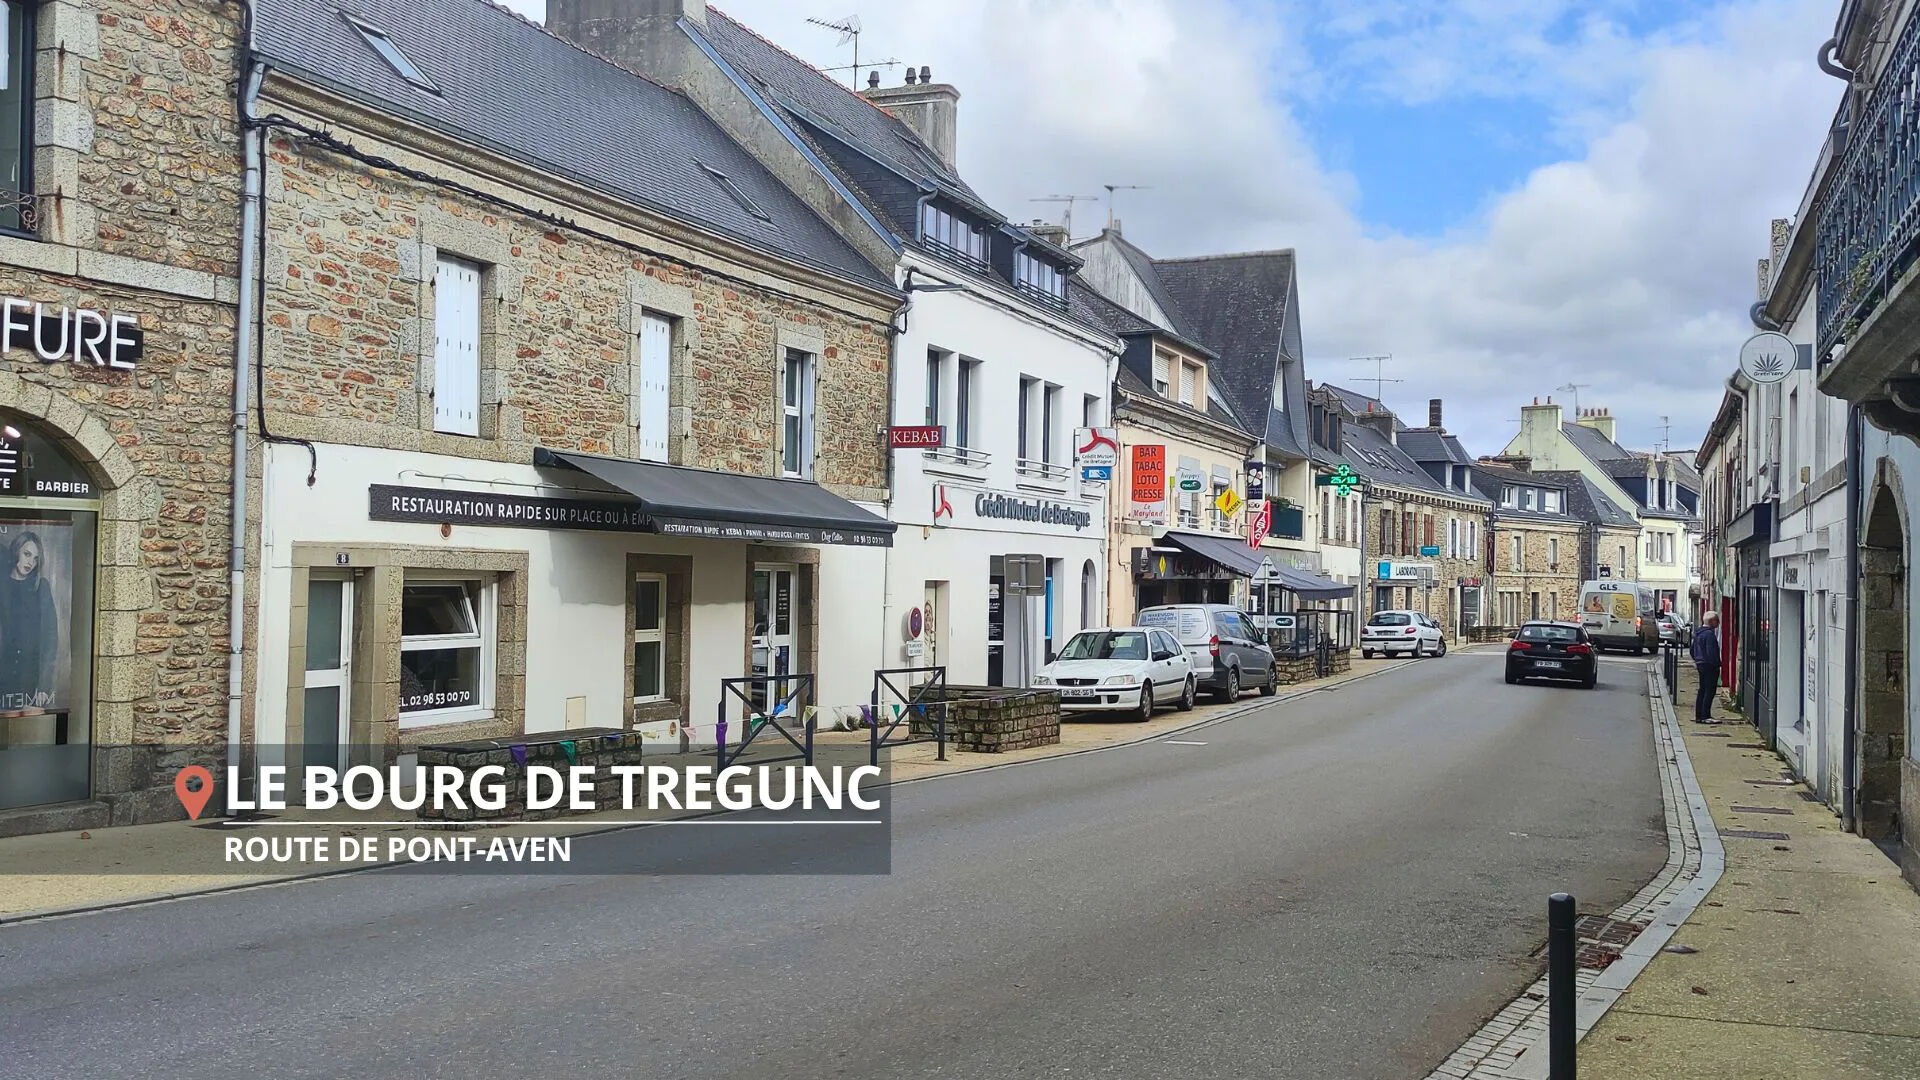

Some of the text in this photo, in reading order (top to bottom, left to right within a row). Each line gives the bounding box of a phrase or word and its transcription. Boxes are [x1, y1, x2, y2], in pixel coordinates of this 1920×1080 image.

[2, 297, 138, 369] FURE
[892, 430, 939, 443] KEBAB
[1139, 447, 1157, 457] BAR
[1135, 461, 1162, 471] TABAC
[1136, 474, 1159, 485] LOTO
[36, 480, 89, 493] BARBIER
[1133, 488, 1163, 499] PRESSE
[391, 496, 652, 526] RESTAURATION RAPIDE SUR PLACE OU À EMP
[975, 492, 1091, 532] Crédit Mutuel de Bretagne
[341, 554, 346, 563] 8
[1599, 583, 1618, 591] GLS
[410, 695, 421, 706] 02
[423, 692, 434, 706] 98
[435, 692, 446, 705] 53
[446, 691, 459, 702] 00
[459, 690, 470, 703] 70
